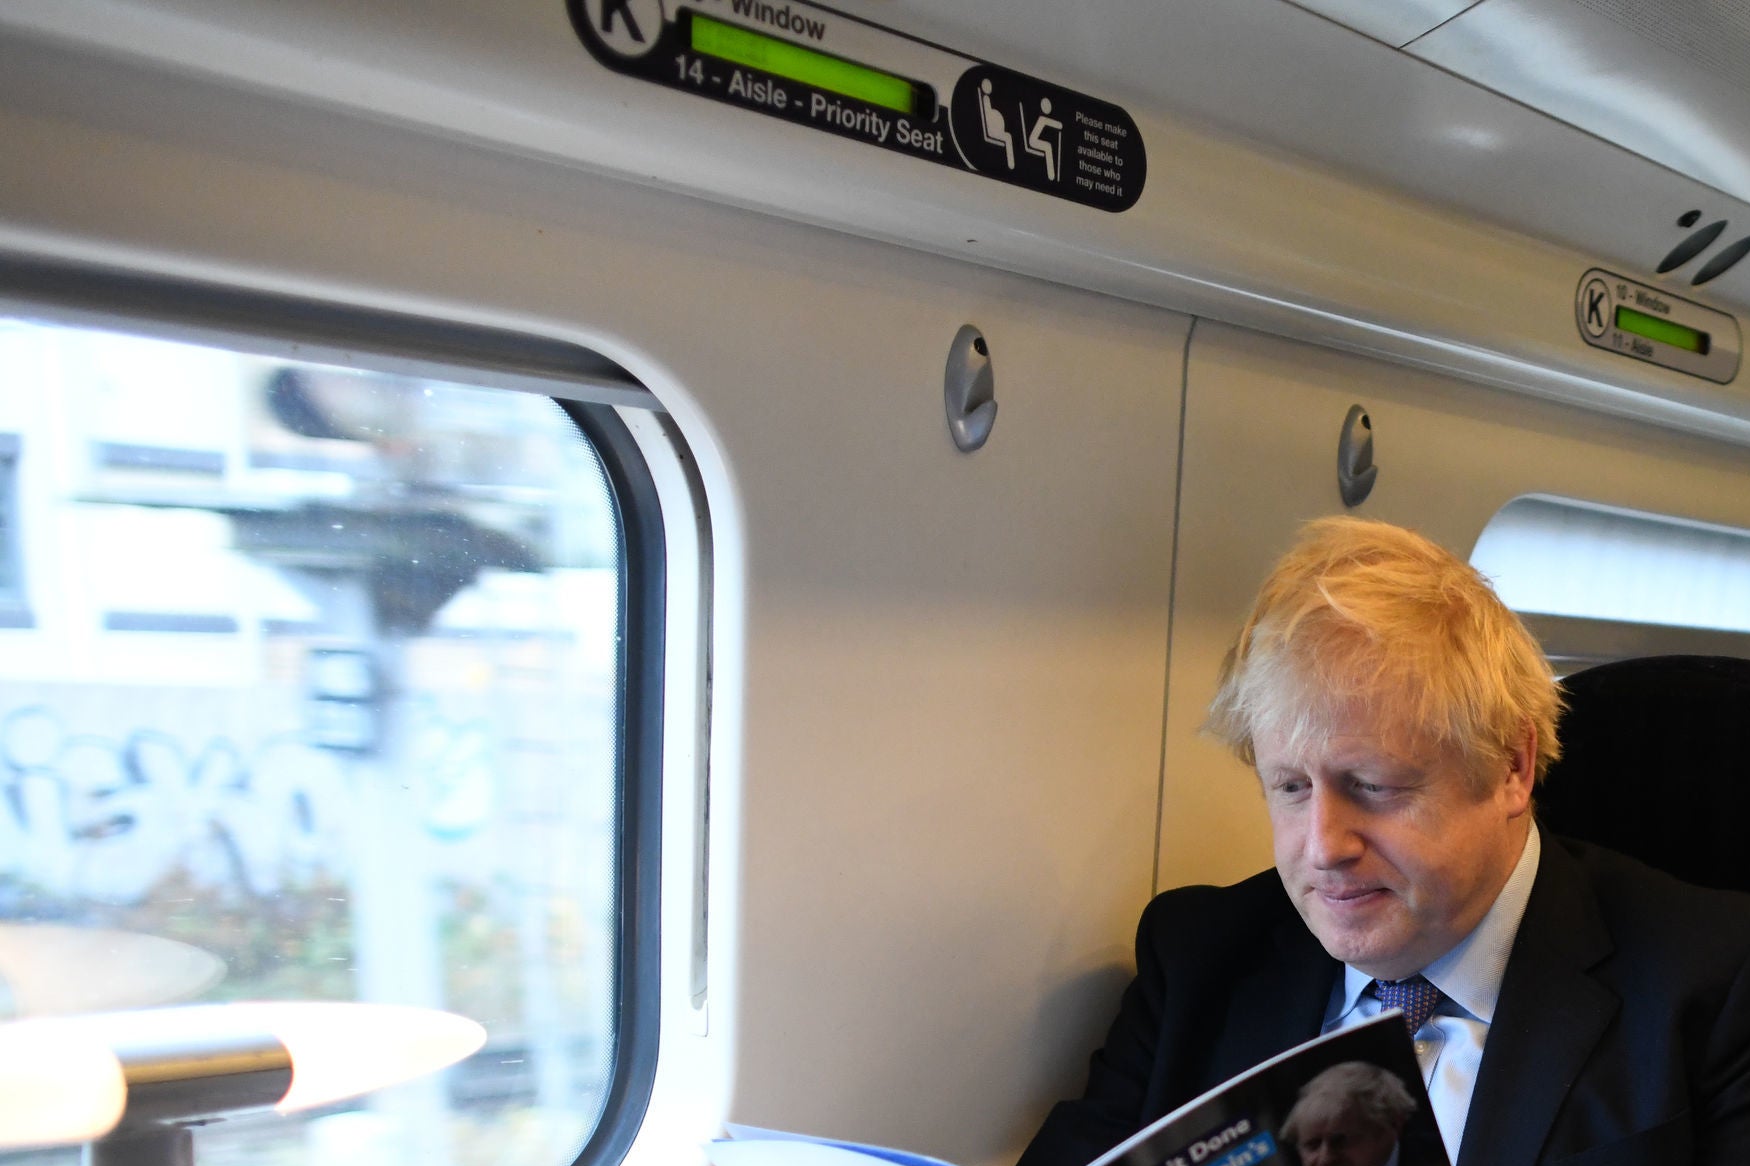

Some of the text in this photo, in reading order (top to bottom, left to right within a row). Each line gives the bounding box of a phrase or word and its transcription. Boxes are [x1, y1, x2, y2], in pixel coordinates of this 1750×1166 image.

[732, 0, 825, 41] Window
[675, 54, 705, 85] 14
[728, 69, 788, 109] Aisle
[809, 92, 891, 143] Priority
[895, 118, 945, 155] Seat
[1075, 111, 1128, 138] Please make
[1083, 130, 1119, 150] this seat
[1077, 145, 1124, 167] available to
[1078, 159, 1121, 182] those who
[1076, 175, 1123, 197] may need it
[1587, 288, 1605, 328] K
[1187, 1118, 1251, 1163] Done
